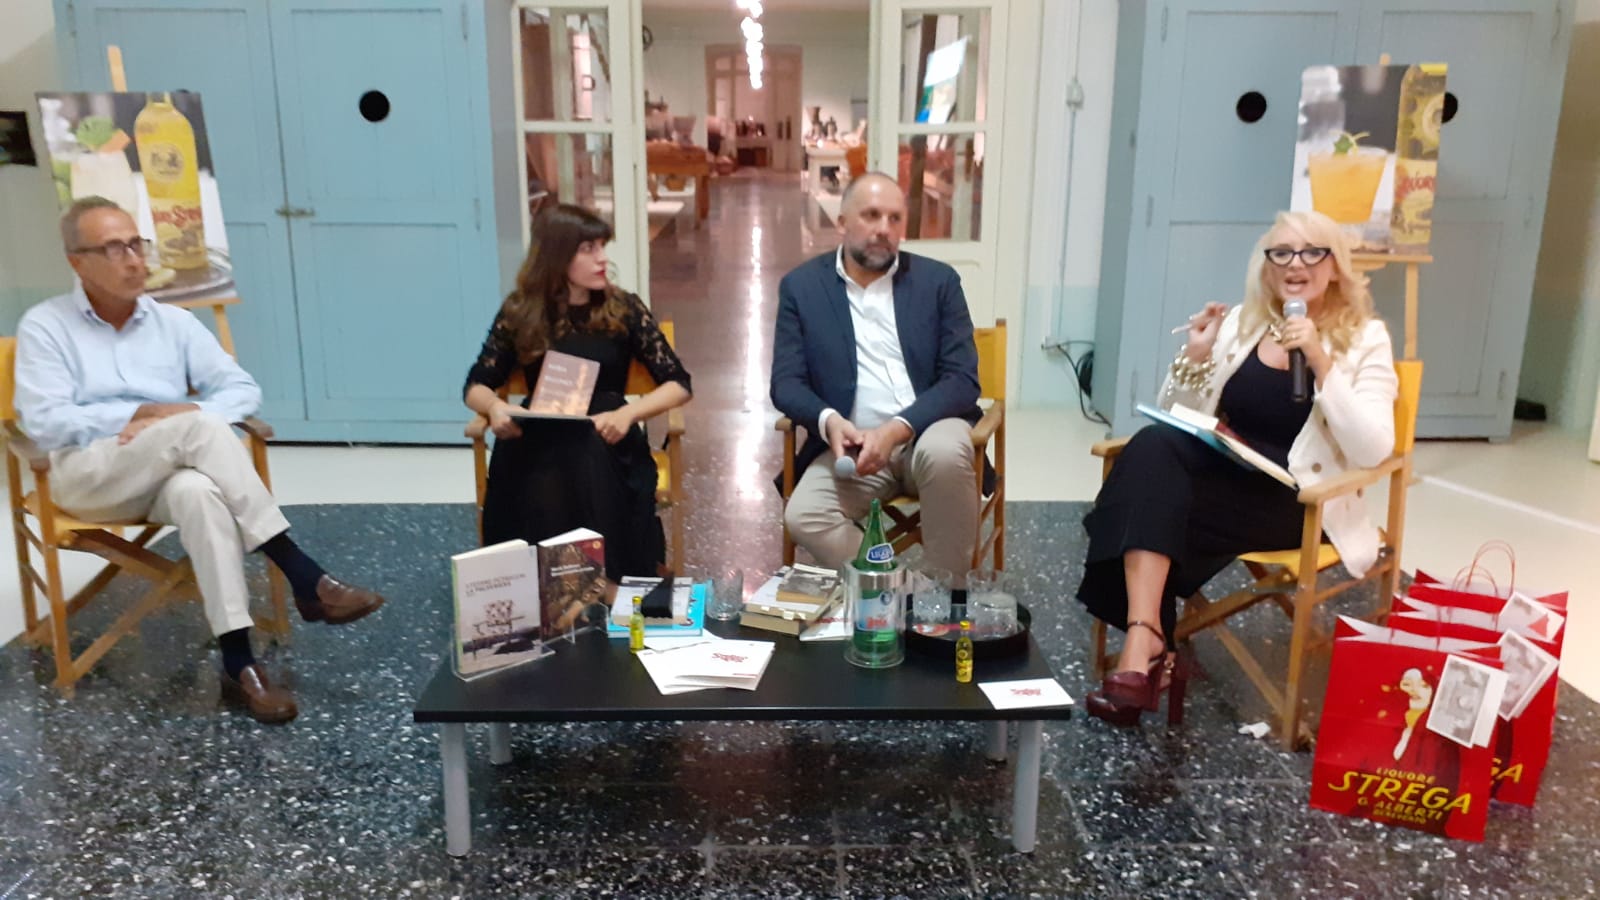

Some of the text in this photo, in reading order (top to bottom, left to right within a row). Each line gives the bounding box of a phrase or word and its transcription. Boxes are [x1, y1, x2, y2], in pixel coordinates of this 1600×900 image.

[1376, 767, 1436, 784] LIQUORE
[1327, 771, 1472, 815] STREGA
[1375, 800, 1444, 820] ALBERTI
